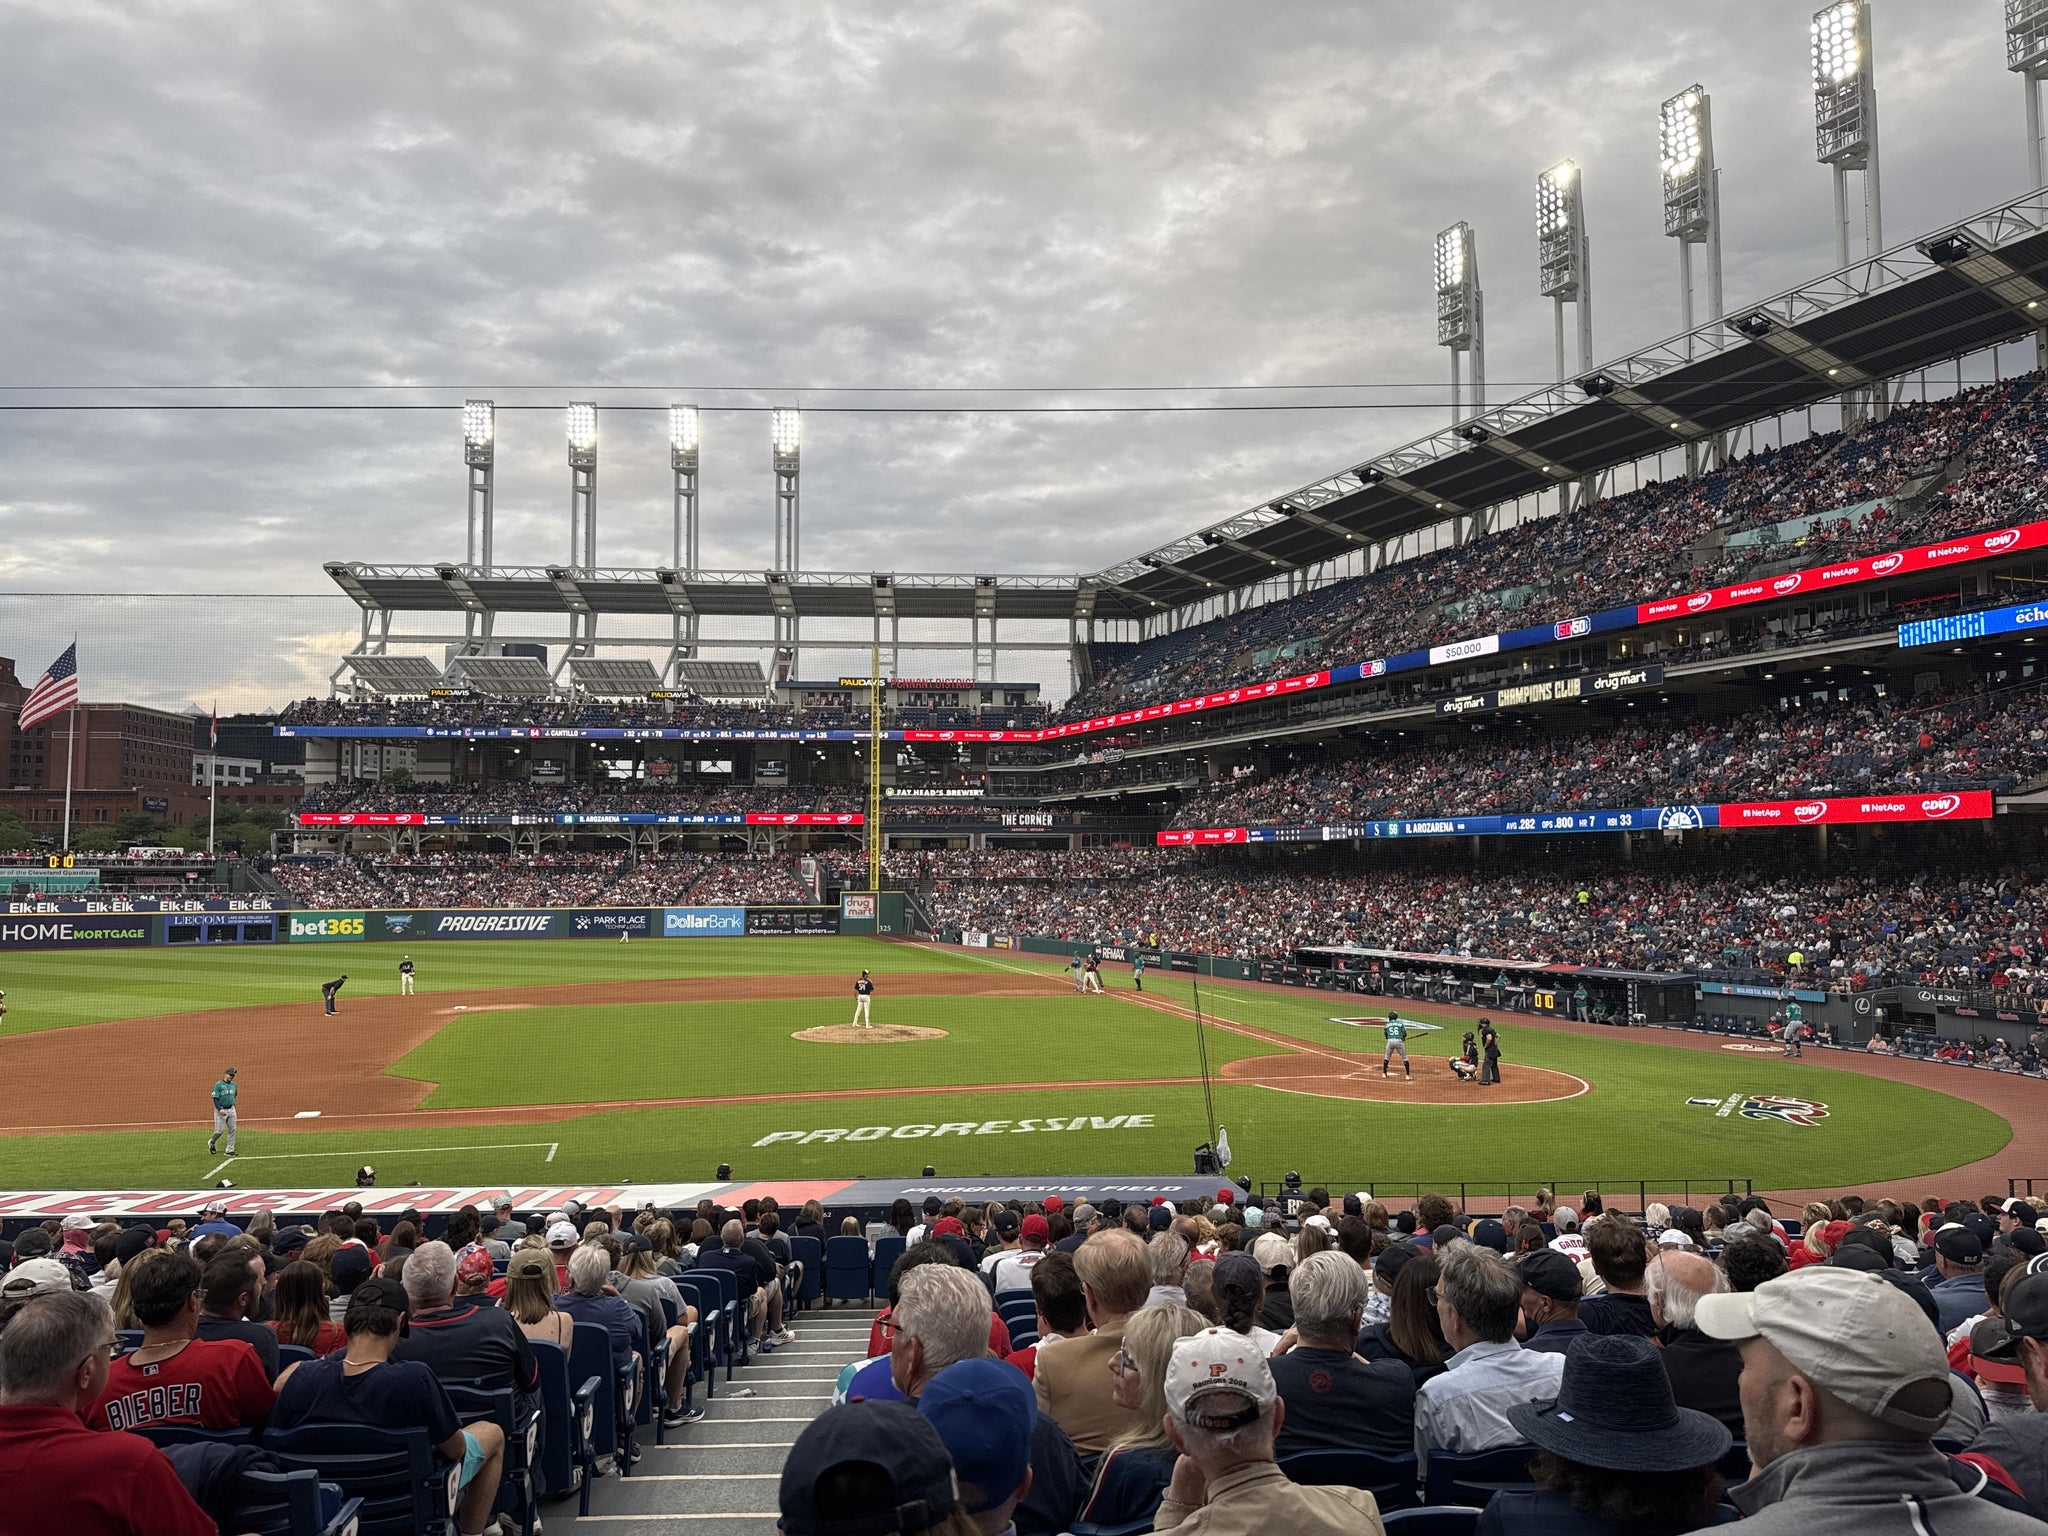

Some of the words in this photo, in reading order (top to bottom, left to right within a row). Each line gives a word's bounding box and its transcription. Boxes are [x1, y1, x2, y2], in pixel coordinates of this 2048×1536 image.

[1937, 545, 1970, 557] NetApp
[1831, 567, 1860, 578] NetApp
[1738, 586, 1763, 596] NetApp
[1655, 604, 1678, 613] NetApp
[1445, 642, 1482, 659] $50,000
[890, 679, 933, 689] PENNANT
[936, 679, 977, 689] DISTRICT
[1594, 677, 1619, 690] drug
[1620, 671, 1646, 686] mart
[1497, 682, 1552, 707] CHAMPIONS
[1554, 678, 1581, 699] CLUB
[1443, 699, 1463, 713] drug
[1463, 696, 1484, 709] mart
[1751, 808, 1781, 818] NetApp
[1871, 803, 1906, 812] NetApp
[1001, 814, 1017, 826] THE
[1019, 813, 1053, 826] CORNER
[1518, 818, 1535, 830] .282
[1554, 816, 1574, 829] .800
[1589, 815, 1595, 828] 7
[1619, 814, 1632, 825] 33
[1389, 823, 1398, 835] 56
[1405, 823, 1412, 834] R.
[1412, 821, 1454, 834] AROZARENA
[846, 898, 870, 911] drug
[848, 907, 874, 916] mart
[437, 915, 550, 932] PROGRESSIVE
[593, 916, 617, 924] PARK
[2, 923, 74, 941] HOME
[73, 929, 145, 939] MORTGAGE
[290, 918, 365, 936] bet365
[880, 924, 892, 932] 325
[1388, 1027, 1399, 1036] 56
[751, 1113, 1157, 1147] PROGRESSIVE
[899, 1184, 1096, 1194] PROGRESSIVE
[1100, 1184, 1185, 1192] FIELD
[1209, 1363, 1227, 1377] P
[1192, 1378, 1227, 1390] Reunions
[1228, 1377, 1248, 1388] 2008
[105, 1382, 202, 1432] BIEBER
